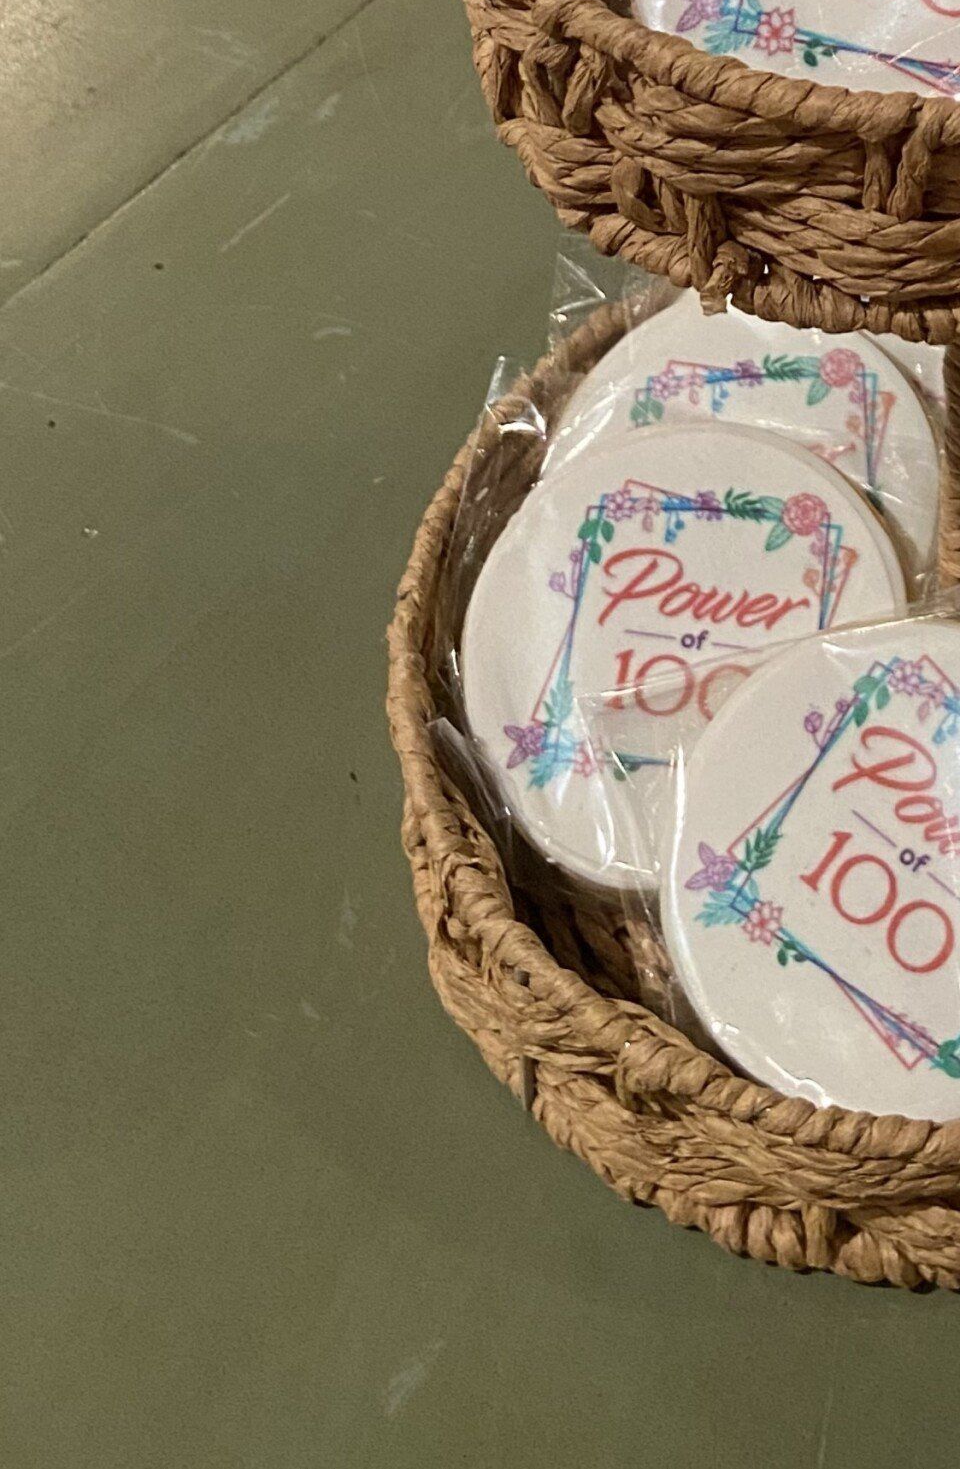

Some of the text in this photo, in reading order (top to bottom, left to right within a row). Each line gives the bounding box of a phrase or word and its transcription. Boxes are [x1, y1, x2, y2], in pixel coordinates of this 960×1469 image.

[598, 548, 810, 630] Power
[680, 630, 709, 651] of
[899, 848, 931, 873] of
[799, 831, 955, 974] 100
